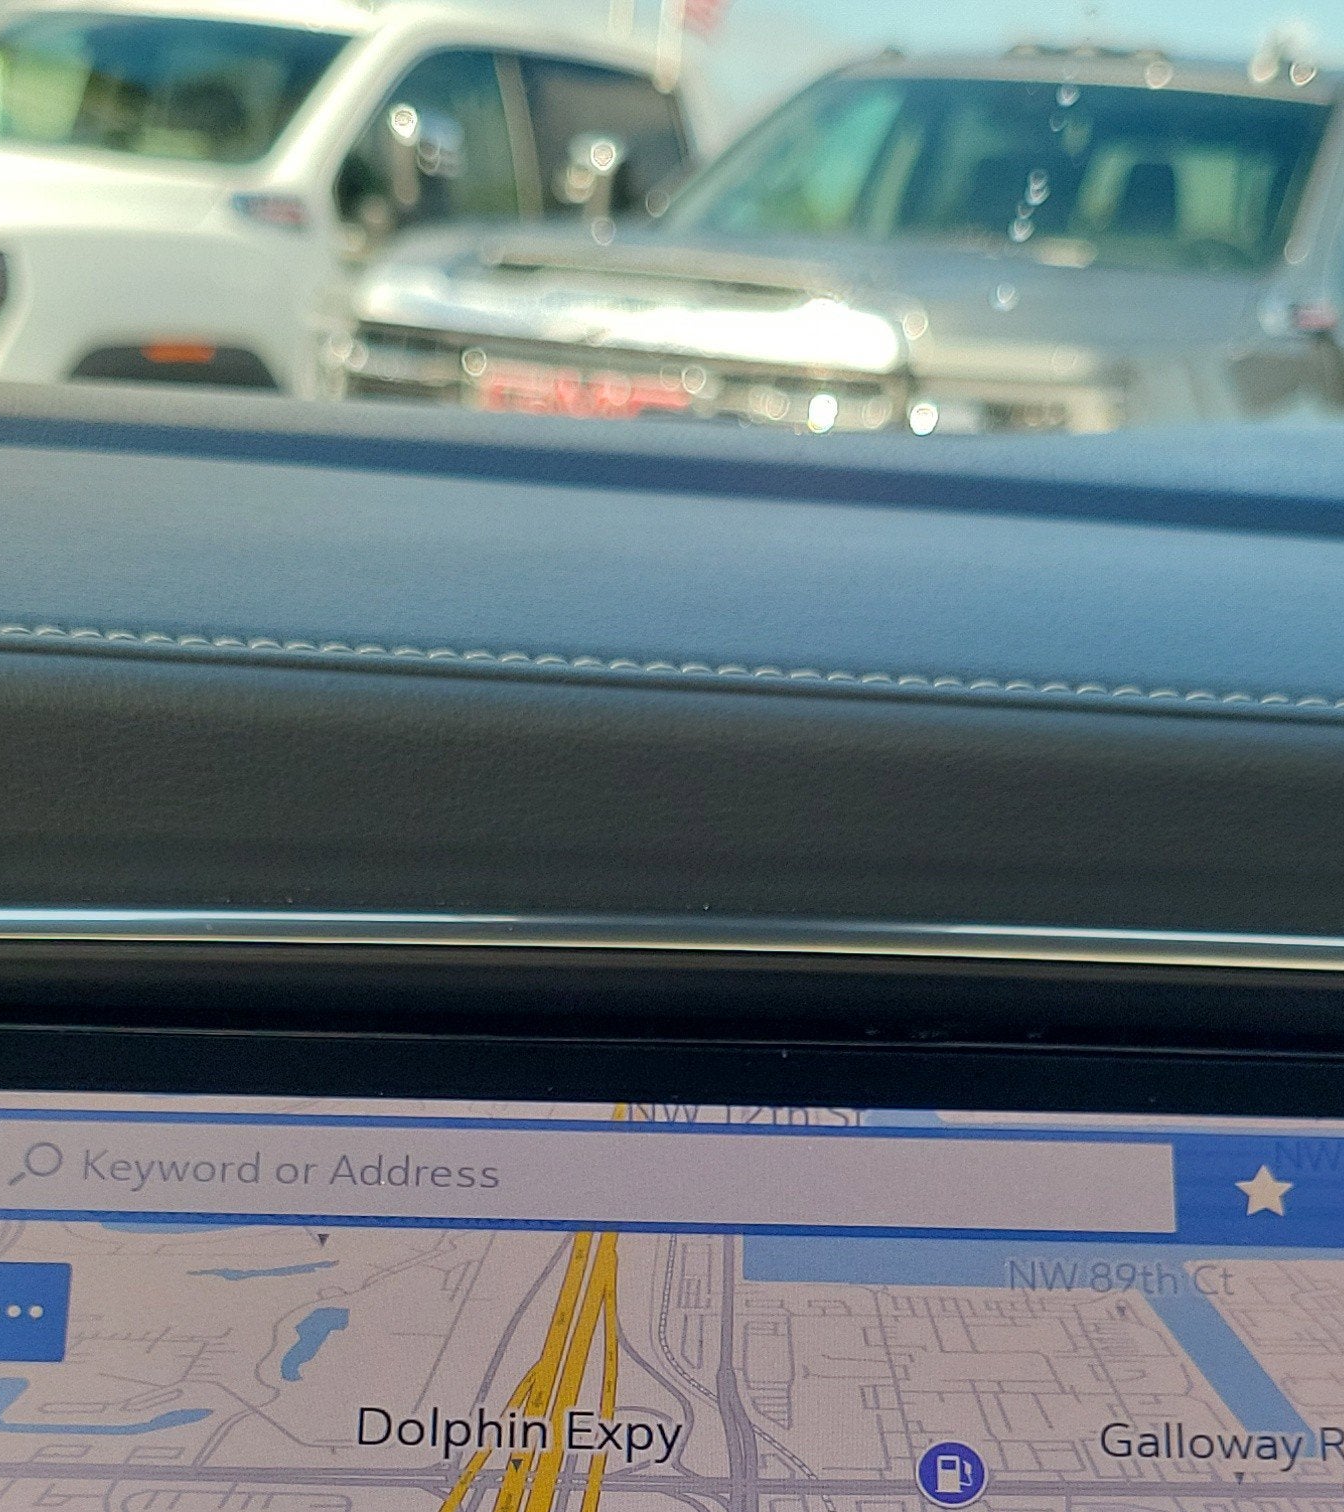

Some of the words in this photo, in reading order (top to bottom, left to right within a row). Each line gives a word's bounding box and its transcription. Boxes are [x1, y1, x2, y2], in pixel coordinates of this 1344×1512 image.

[83, 1149, 260, 1191] Keyword
[275, 1158, 317, 1184] or
[329, 1154, 500, 1188] Address
[1008, 1260, 1078, 1291] NW
[1090, 1262, 1178, 1295] 89th
[1193, 1264, 1235, 1296] Ct
[358, 1406, 547, 1459] Dolphin
[567, 1411, 683, 1463] Expy
[1100, 1422, 1303, 1472] Galloway
